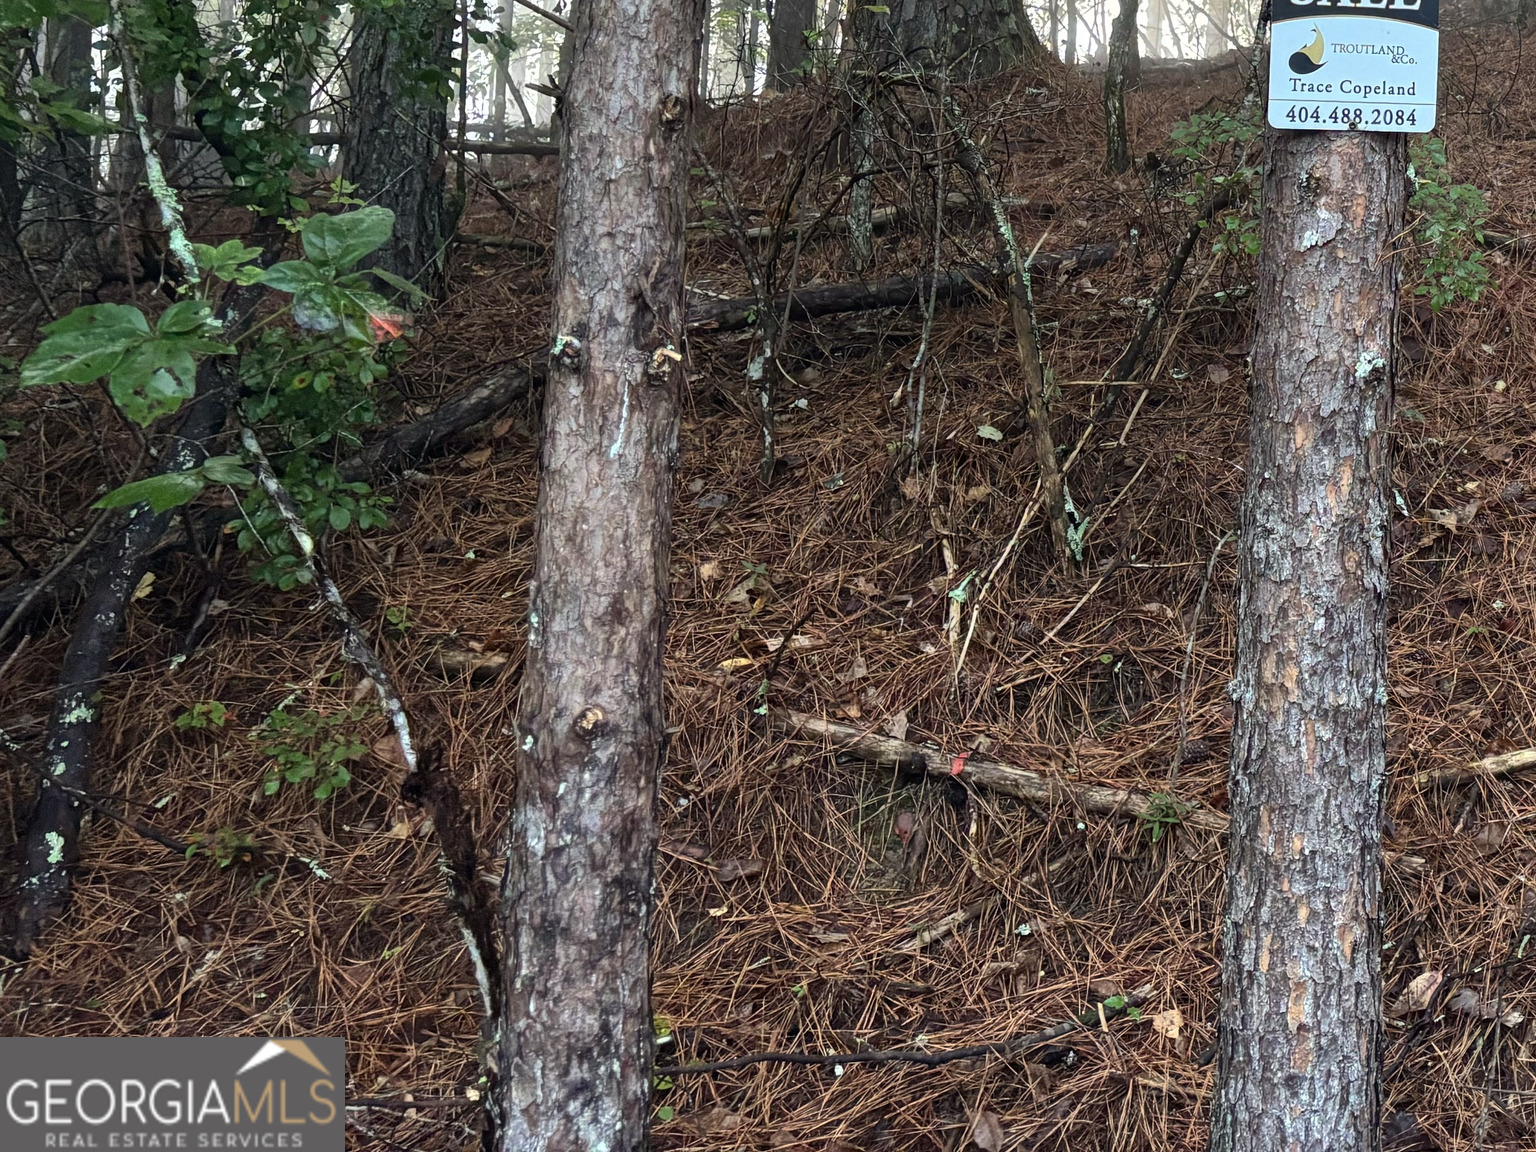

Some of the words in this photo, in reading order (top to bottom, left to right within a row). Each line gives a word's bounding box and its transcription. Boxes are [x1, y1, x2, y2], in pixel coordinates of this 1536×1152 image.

[1331, 43, 1405, 56] TROUTLAND
[1289, 78, 1333, 93] Trace
[1339, 79, 1416, 98] Copeland
[1286, 104, 1417, 126] 404.488.2084
